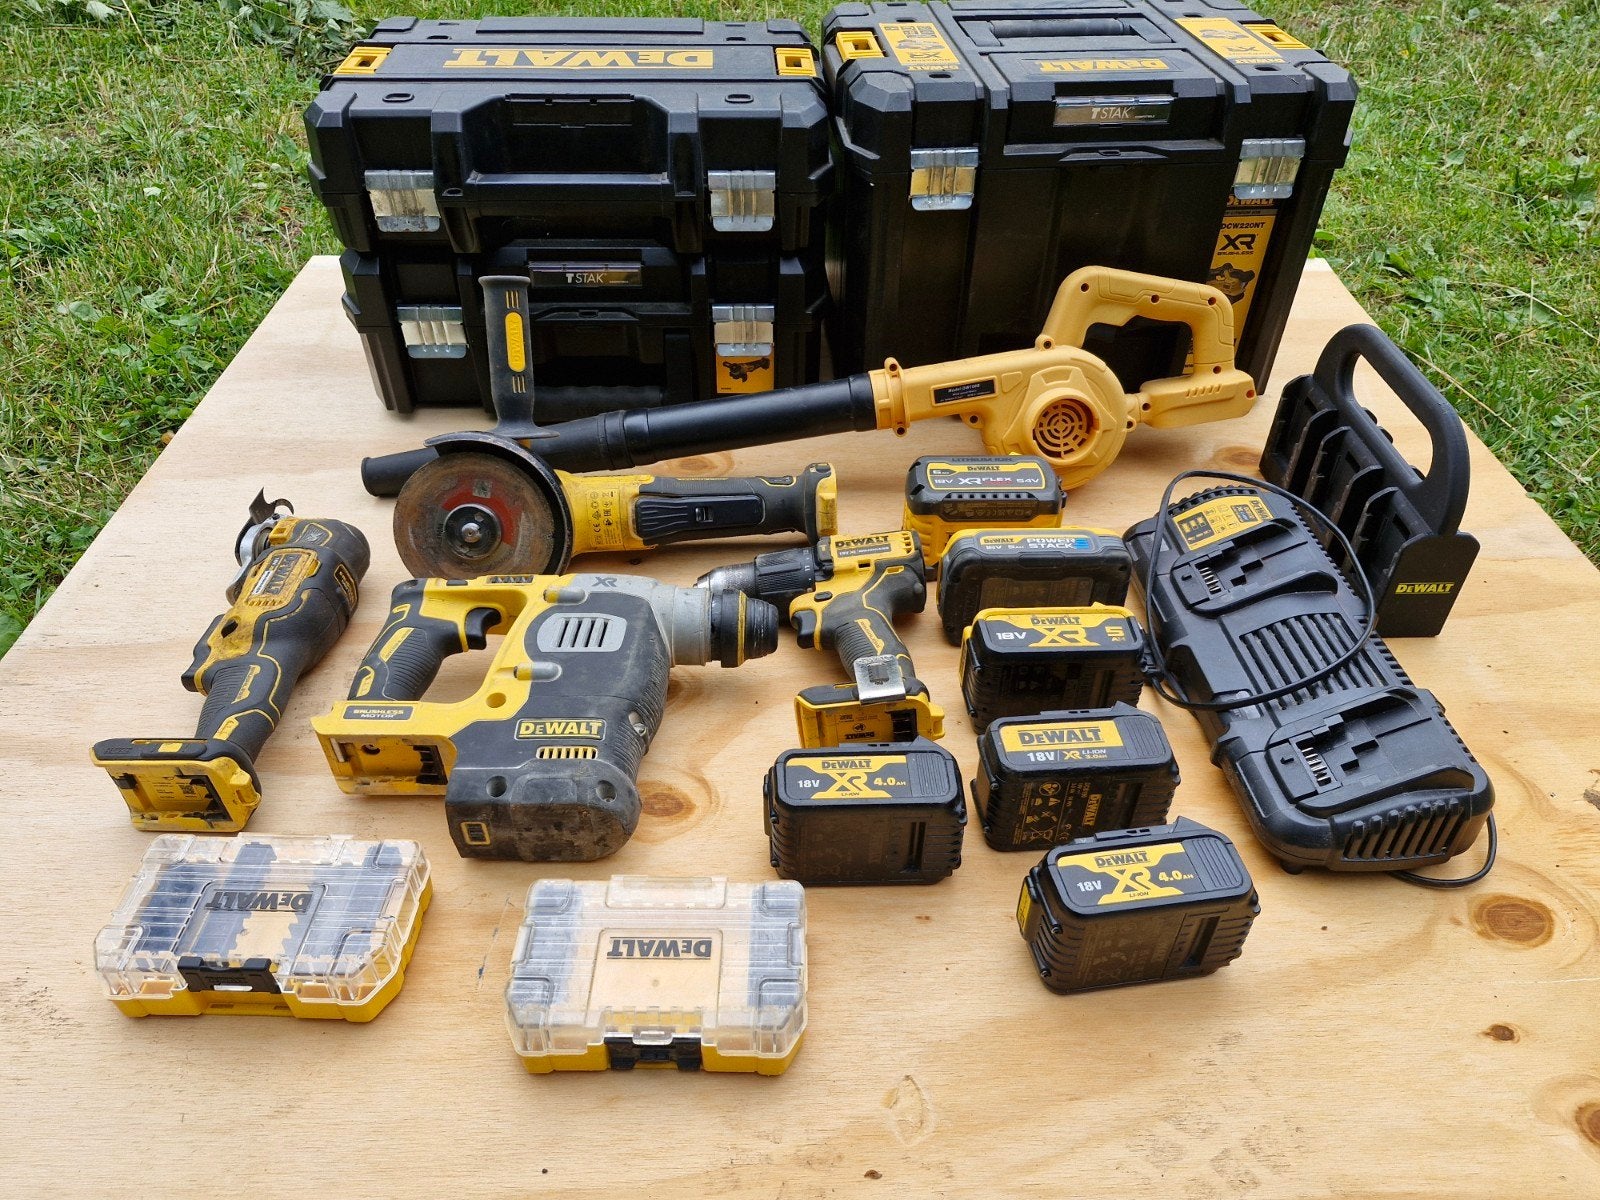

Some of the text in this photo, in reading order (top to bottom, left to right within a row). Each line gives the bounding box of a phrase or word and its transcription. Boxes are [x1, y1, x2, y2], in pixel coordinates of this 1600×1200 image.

[444, 49, 713, 67] DEWALT
[1037, 58, 1169, 73] DEWALT
[1220, 234, 1257, 250] XR
[958, 477, 982, 485] XR
[835, 536, 889, 548] DEWALT
[592, 577, 618, 587] XR
[1395, 582, 1455, 594] DEWALT
[1031, 616, 1081, 625] DEWALT
[996, 631, 1027, 640] 18V
[1031, 626, 1093, 647] XR
[519, 721, 603, 736] DEWALT
[845, 732, 875, 740] DEWALT
[1018, 728, 1104, 746] DEWALT
[1027, 751, 1055, 762] 18V
[1062, 750, 1082, 760] XR
[821, 760, 872, 770] DEWALT
[798, 779, 820, 788] 18V
[825, 771, 873, 793] XR
[1095, 851, 1149, 868] DEWALT
[1076, 880, 1102, 892] 18V
[1109, 867, 1154, 894] XR
[205, 891, 313, 911] DEWALT
[606, 938, 713, 959] DEWALT
